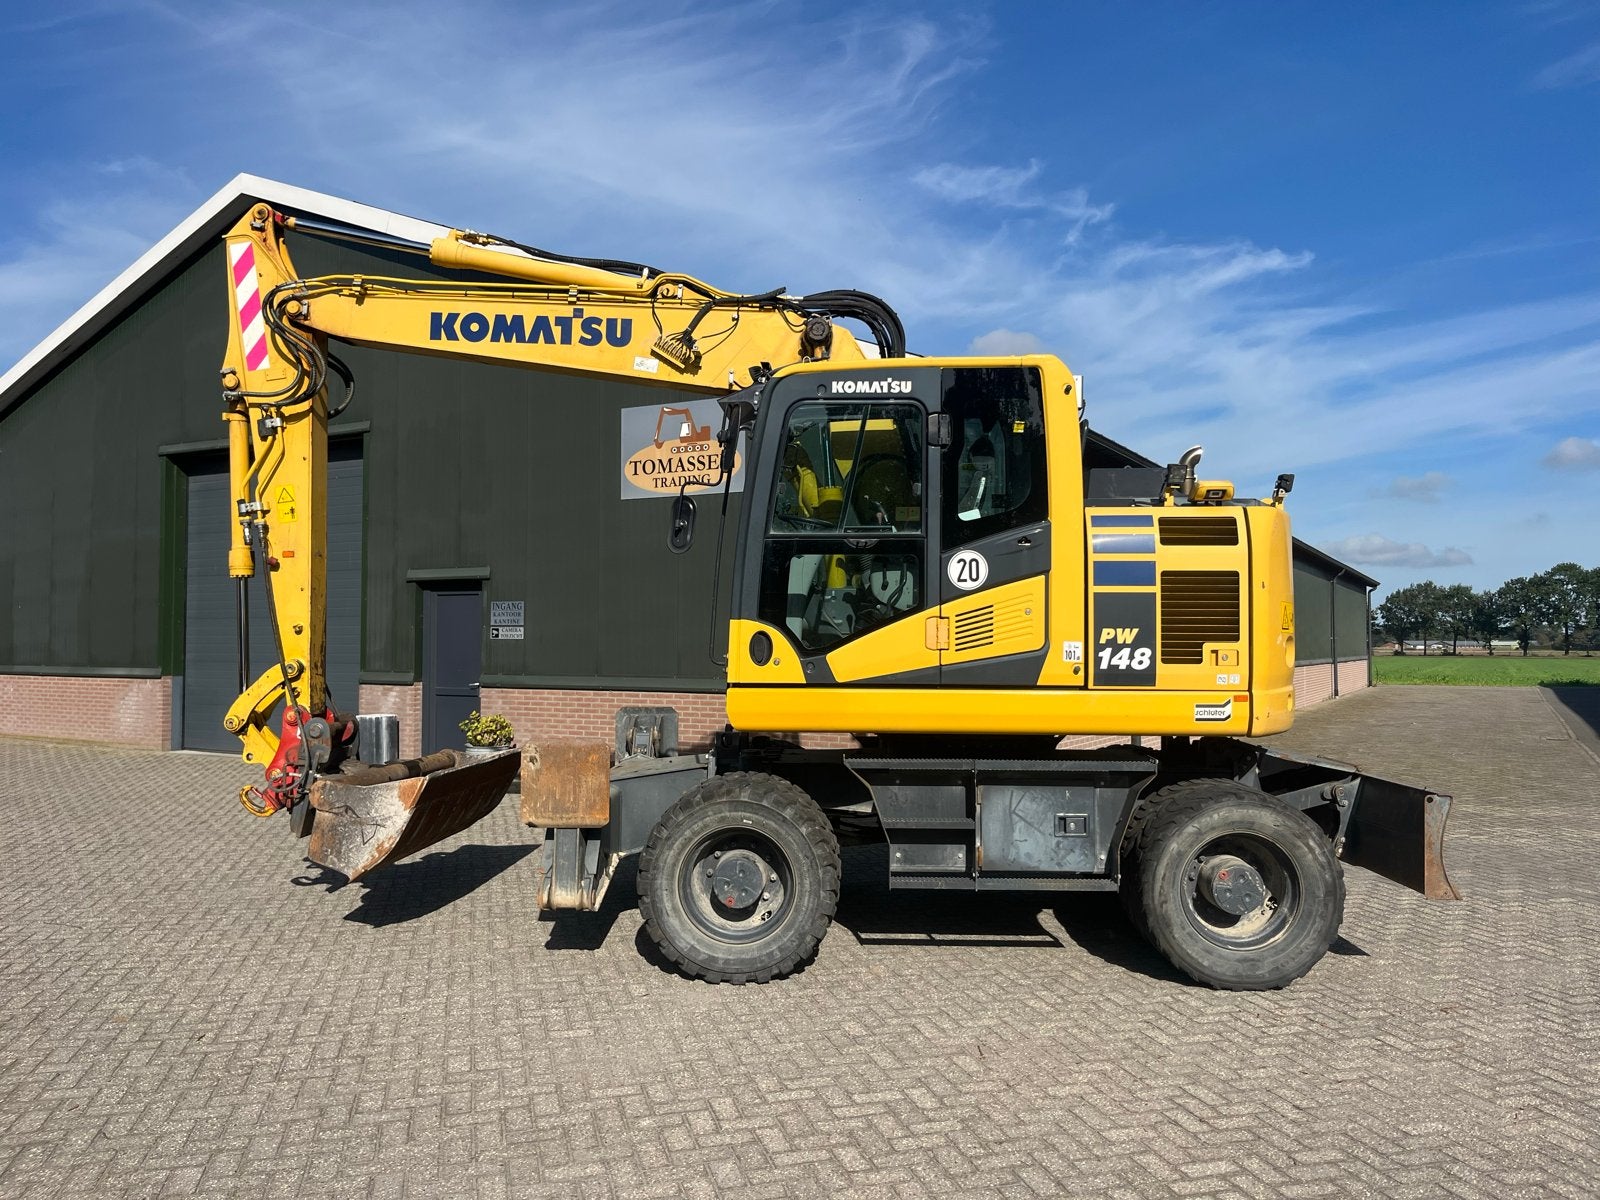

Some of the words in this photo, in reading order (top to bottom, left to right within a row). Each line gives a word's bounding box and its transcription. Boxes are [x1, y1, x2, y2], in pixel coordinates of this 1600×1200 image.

[430, 308, 632, 348] KOMATSU
[831, 378, 912, 393] KOMATSU
[629, 454, 722, 476] TOMASSE
[652, 473, 711, 488] TRADING
[957, 558, 980, 582] 20
[492, 602, 523, 611] INGANG
[1099, 628, 1139, 644] PW
[1098, 647, 1152, 670] 148
